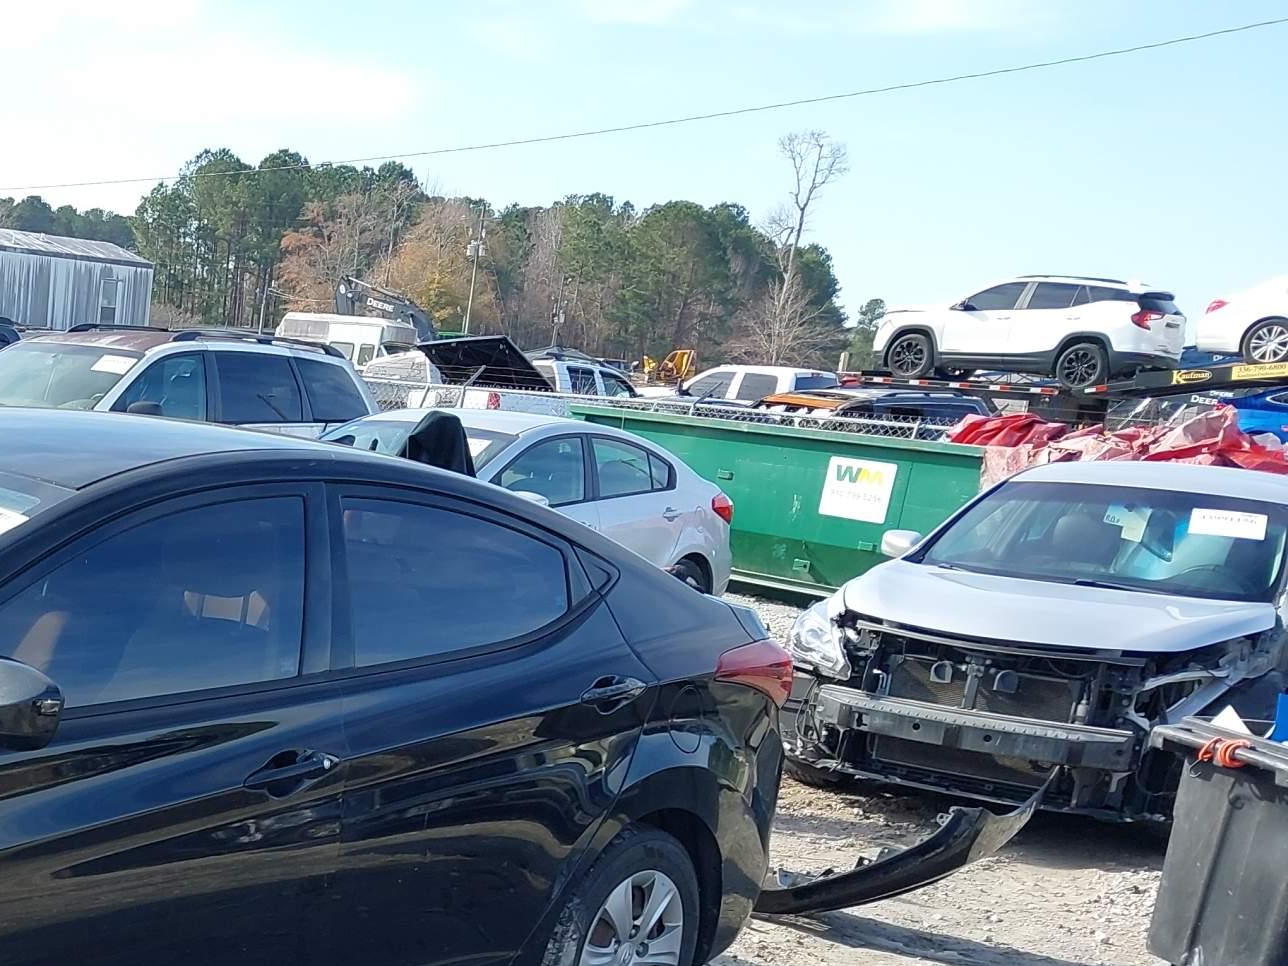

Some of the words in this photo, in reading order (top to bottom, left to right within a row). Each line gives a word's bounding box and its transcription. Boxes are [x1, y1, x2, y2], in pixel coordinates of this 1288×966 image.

[366, 297, 394, 312] DEERE
[1171, 370, 1211, 384] Kaufman
[836, 464, 884, 485] WM
